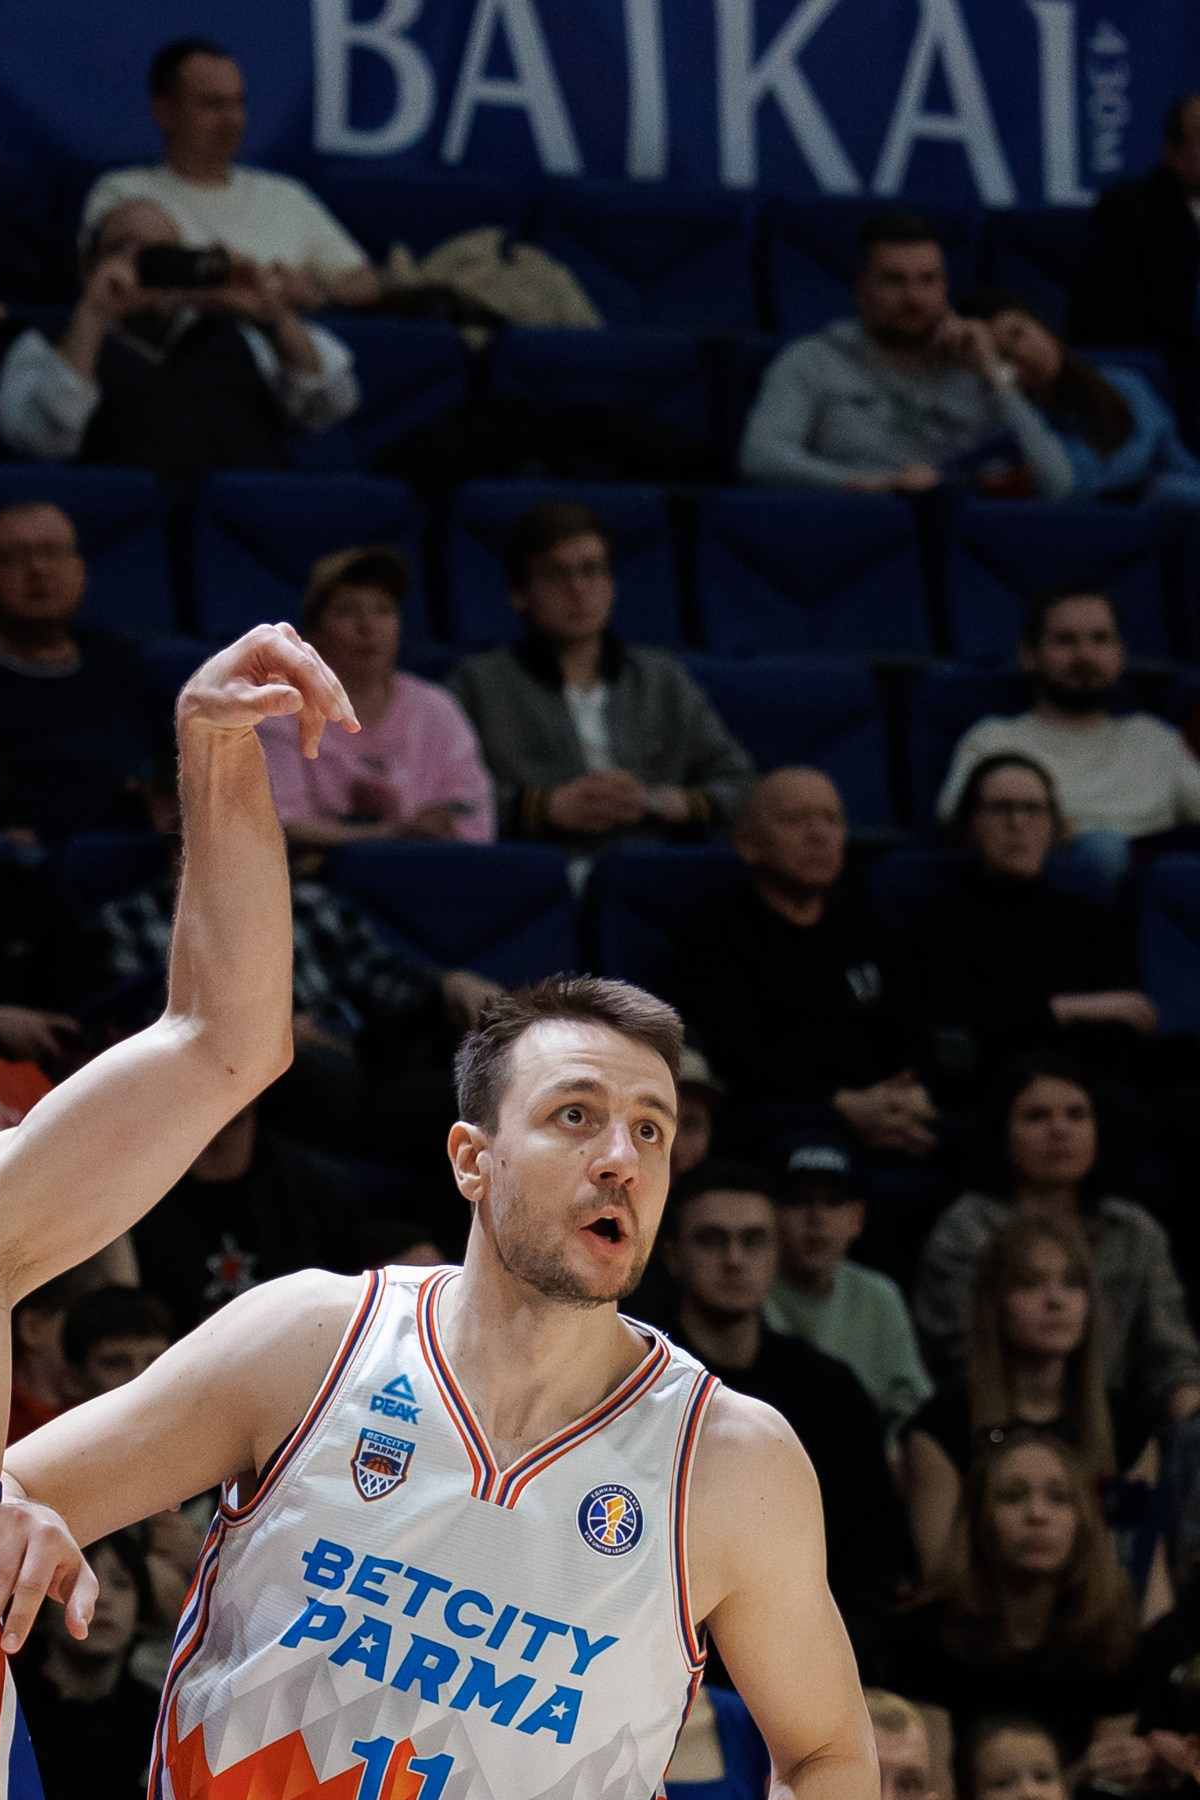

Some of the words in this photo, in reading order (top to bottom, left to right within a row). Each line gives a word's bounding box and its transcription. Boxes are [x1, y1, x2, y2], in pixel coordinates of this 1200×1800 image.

[369, 1394, 423, 1426] PEAK
[366, 1431, 411, 1450] BETCITY
[367, 1442, 402, 1459] PARMA
[301, 1538, 621, 1676] BETCITY
[278, 1595, 584, 1745] PARMA
